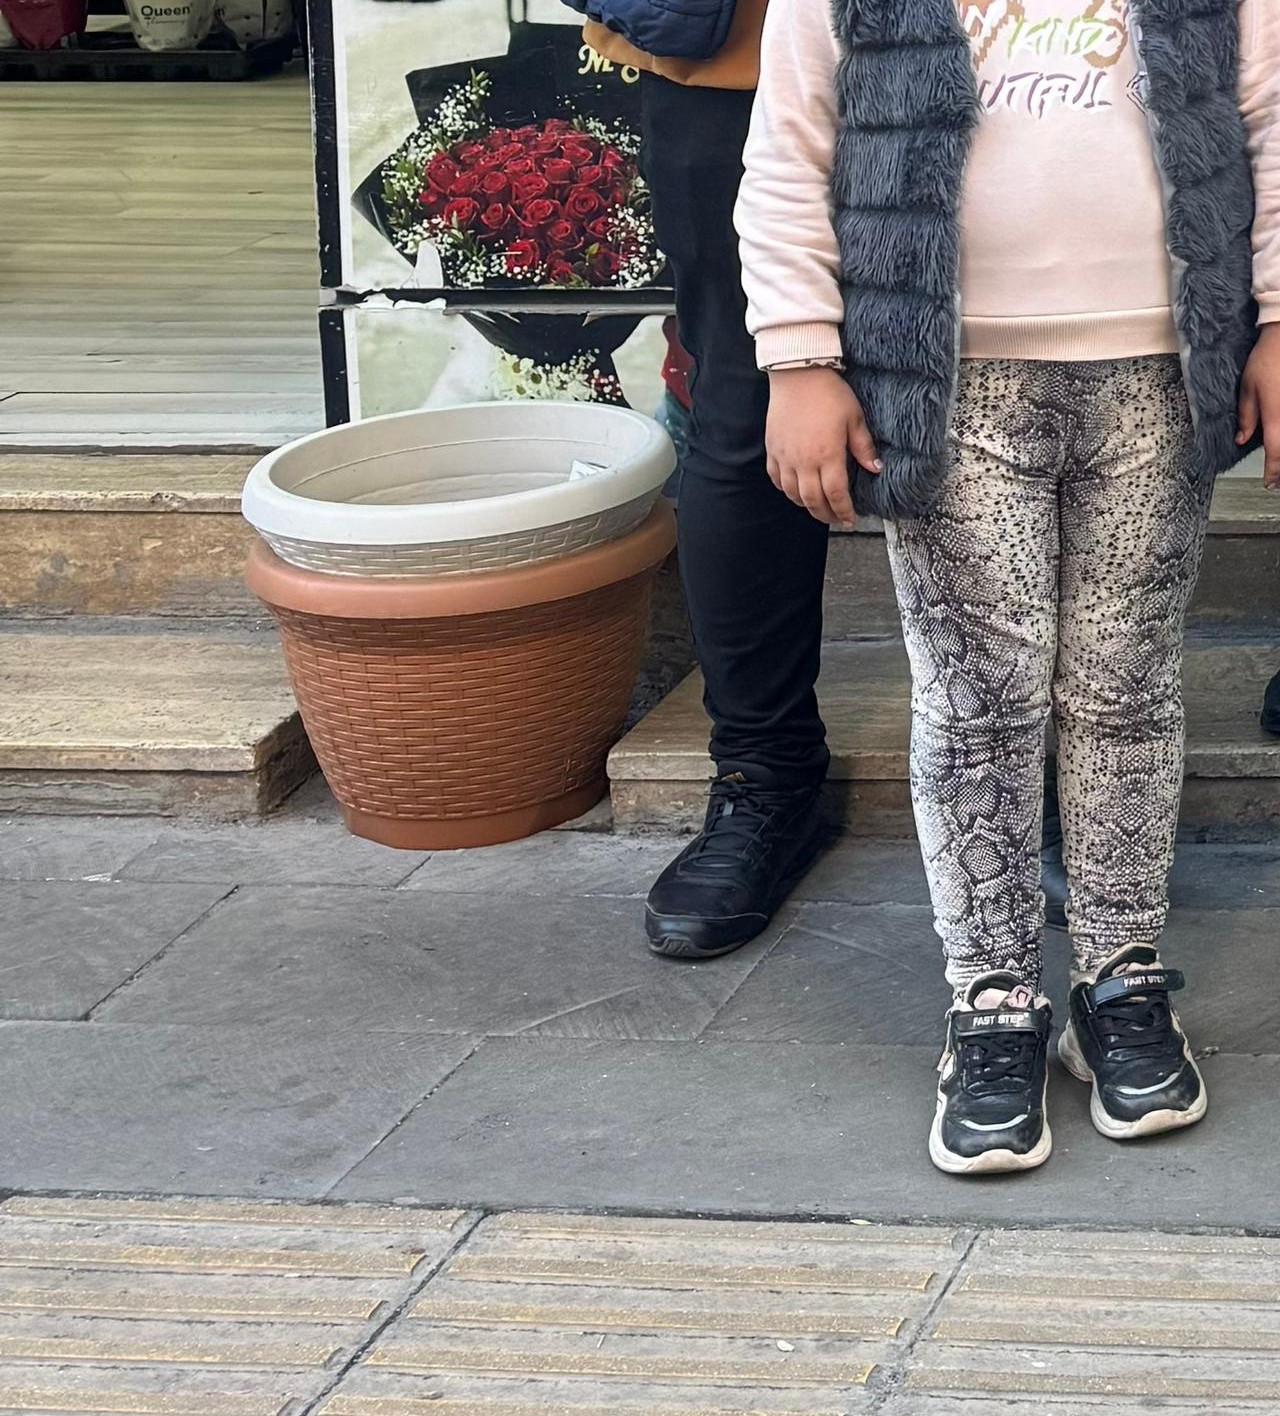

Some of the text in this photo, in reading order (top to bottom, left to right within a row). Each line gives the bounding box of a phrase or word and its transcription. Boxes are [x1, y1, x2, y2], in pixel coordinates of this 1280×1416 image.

[140, 5, 191, 19] Queen
[976, 70, 1117, 120] UTIFUL
[973, 1014, 1024, 1027] FAST STEP
